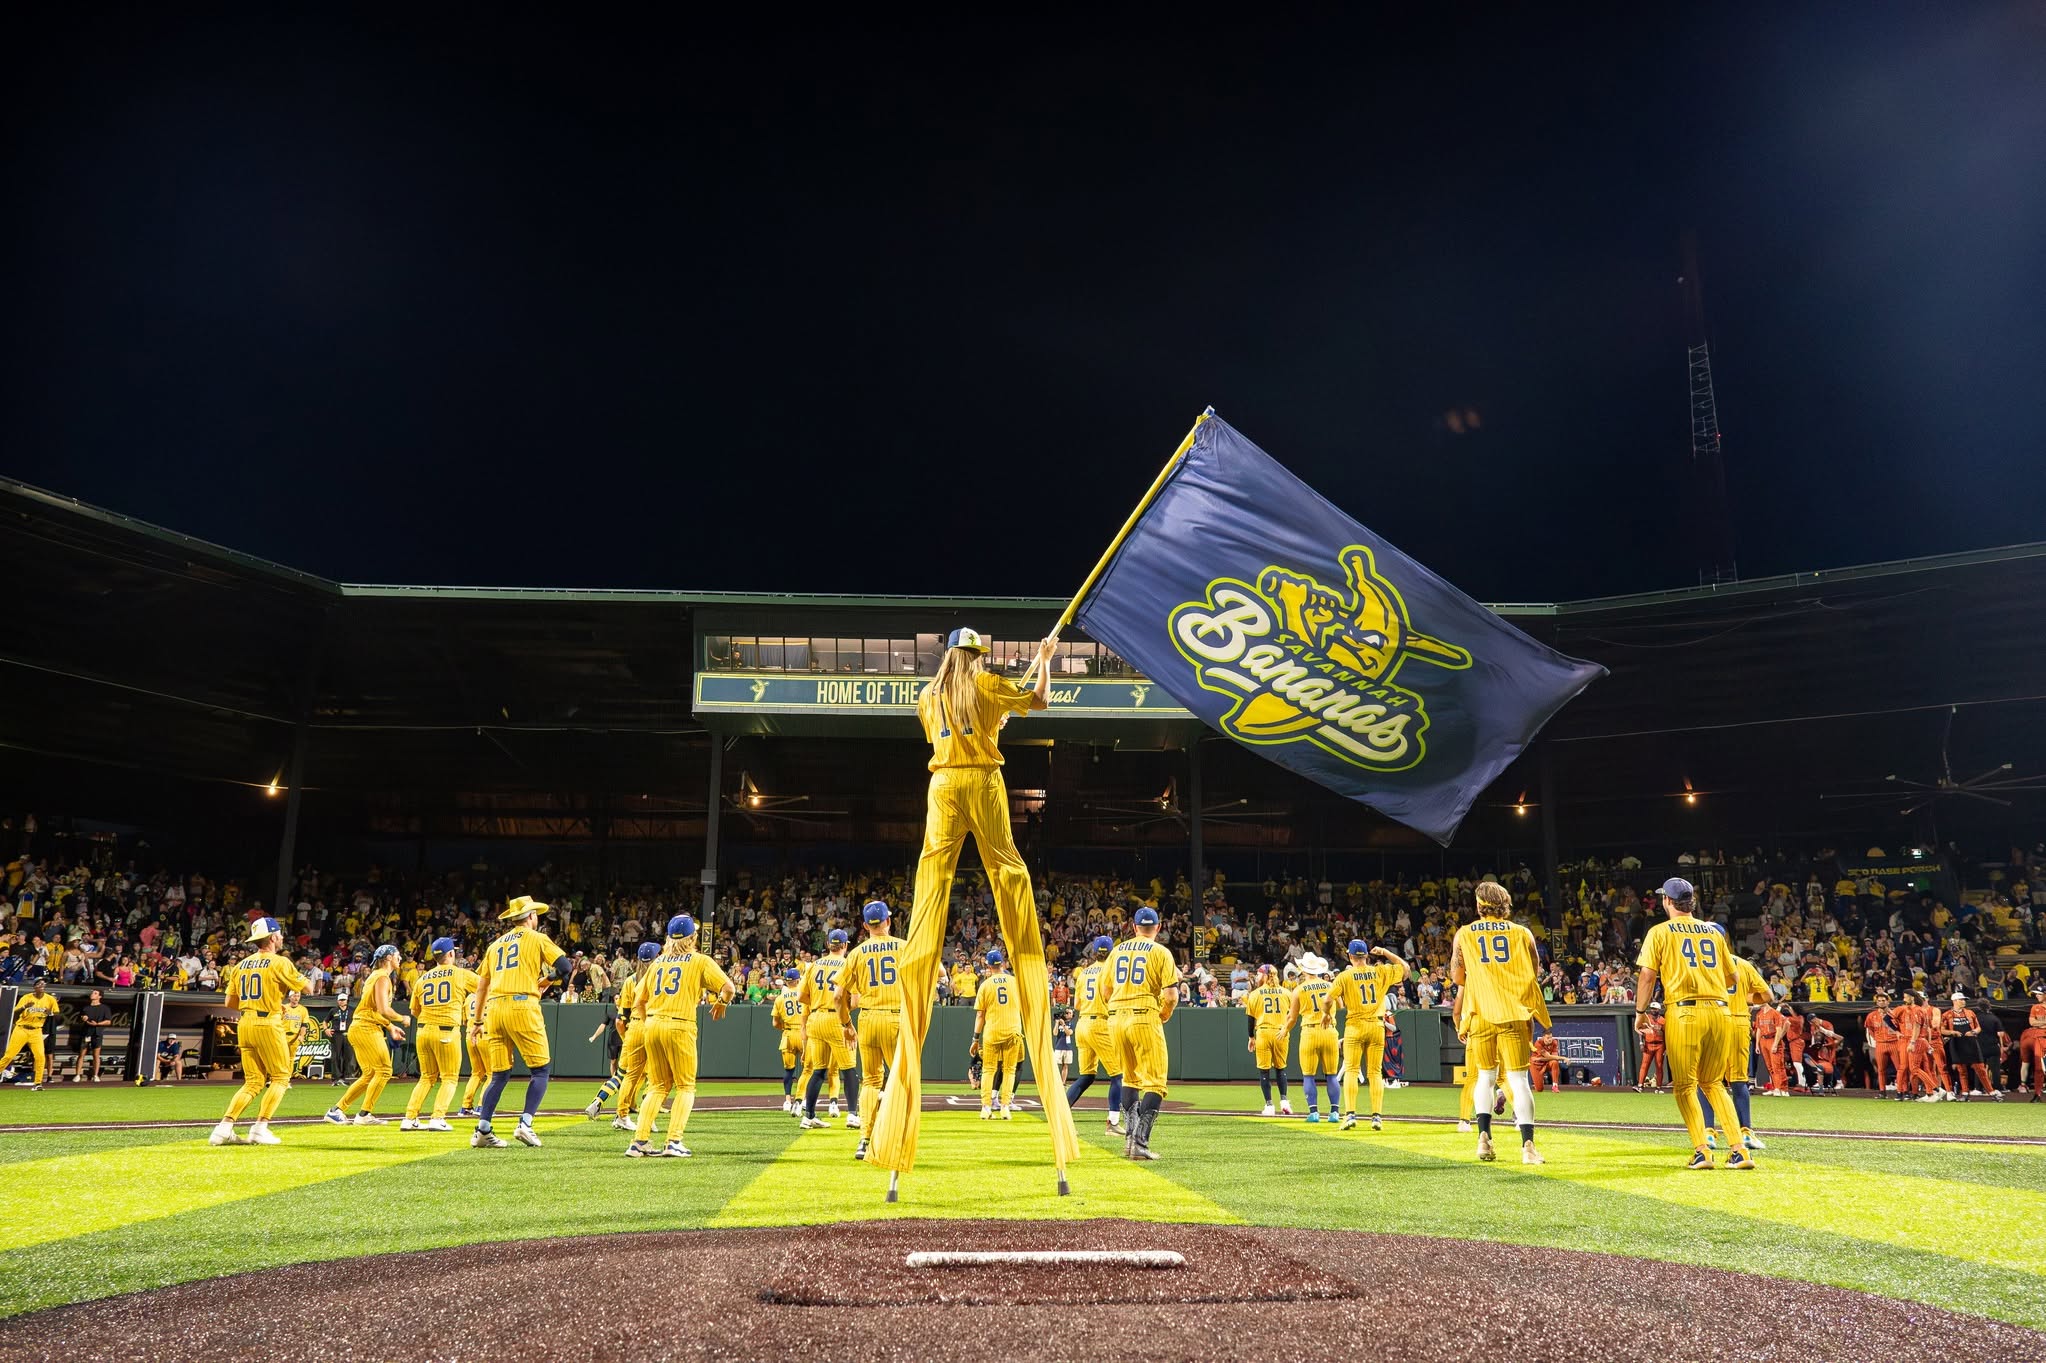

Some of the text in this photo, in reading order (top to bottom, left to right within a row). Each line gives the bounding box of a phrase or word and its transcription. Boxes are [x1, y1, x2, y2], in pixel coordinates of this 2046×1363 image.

[1177, 589, 1412, 760] Bananas
[1274, 632, 1411, 707] SAVANNAH
[817, 681, 862, 704] HOME
[866, 681, 886, 703] OF
[890, 681, 919, 704] THE
[495, 943, 519, 971] 12
[861, 941, 899, 954] VIRANT
[1118, 941, 1154, 952] GILLUM
[1477, 935, 1510, 963] 19
[1681, 938, 1717, 968] 49
[654, 966, 682, 996] 13
[815, 969, 838, 991] 44
[867, 956, 896, 987] 16
[1116, 956, 1146, 985] 66
[240, 973, 262, 1001] 10
[423, 981, 451, 1006] 20
[997, 986, 1008, 1005] 6
[1086, 978, 1096, 1000] 5
[1360, 983, 1377, 1004] 11
[1264, 997, 1281, 1013] 21
